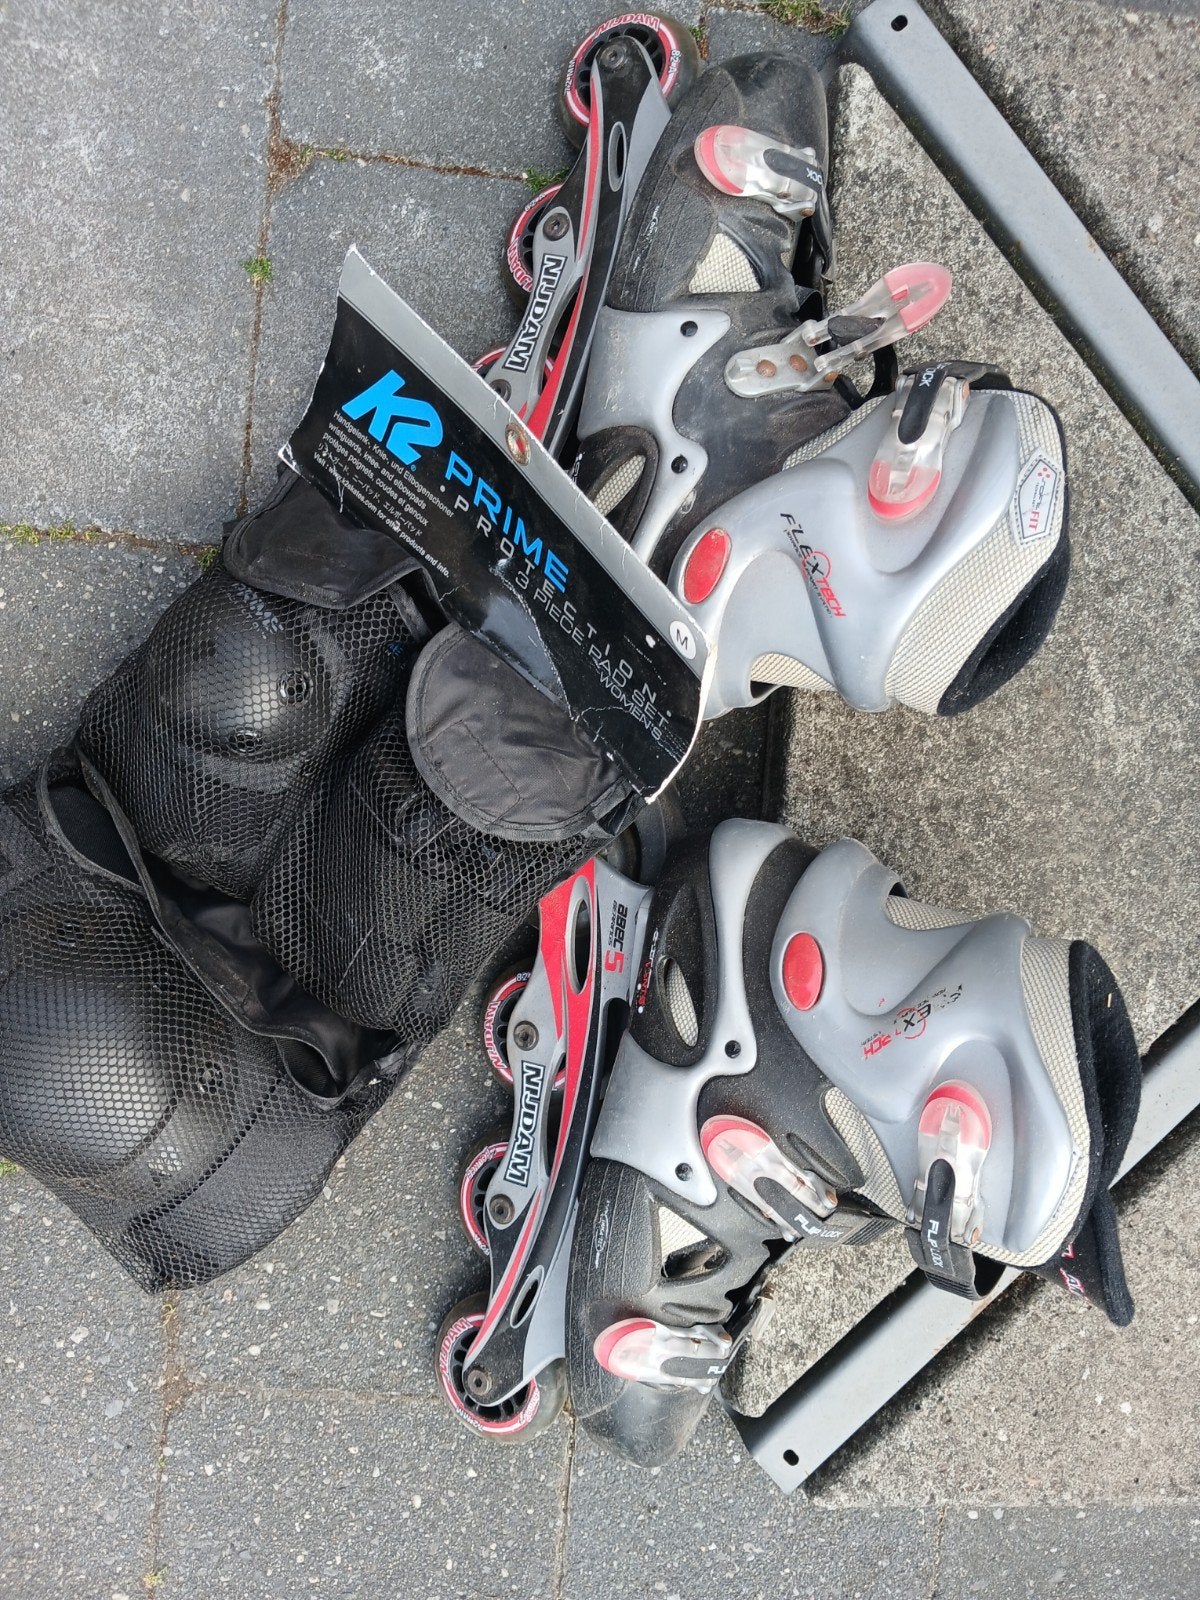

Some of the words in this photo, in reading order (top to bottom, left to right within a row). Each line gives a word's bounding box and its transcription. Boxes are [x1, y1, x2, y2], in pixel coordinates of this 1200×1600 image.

[504, 253, 568, 373] NIJDAM
[341, 369, 444, 466] K2
[361, 450, 383, 471] knee-
[379, 466, 395, 481] and
[393, 478, 427, 511] elbowpads
[389, 459, 405, 474] und
[375, 477, 400, 501] coudes
[396, 495, 406, 506] et
[404, 501, 430, 527] genoux
[445, 451, 570, 593] PRIME
[375, 508, 387, 521] for
[398, 530, 427, 556] products
[424, 552, 439, 567] and
[515, 570, 531, 590] 3
[533, 588, 585, 646] PIECE
[587, 643, 631, 689] PAD
[631, 688, 670, 728] SET
[675, 628, 689, 651] M
[599, 673, 663, 741] WOMEN'S
[604, 950, 626, 974] 5
[503, 1060, 546, 1187] NIJDAM
